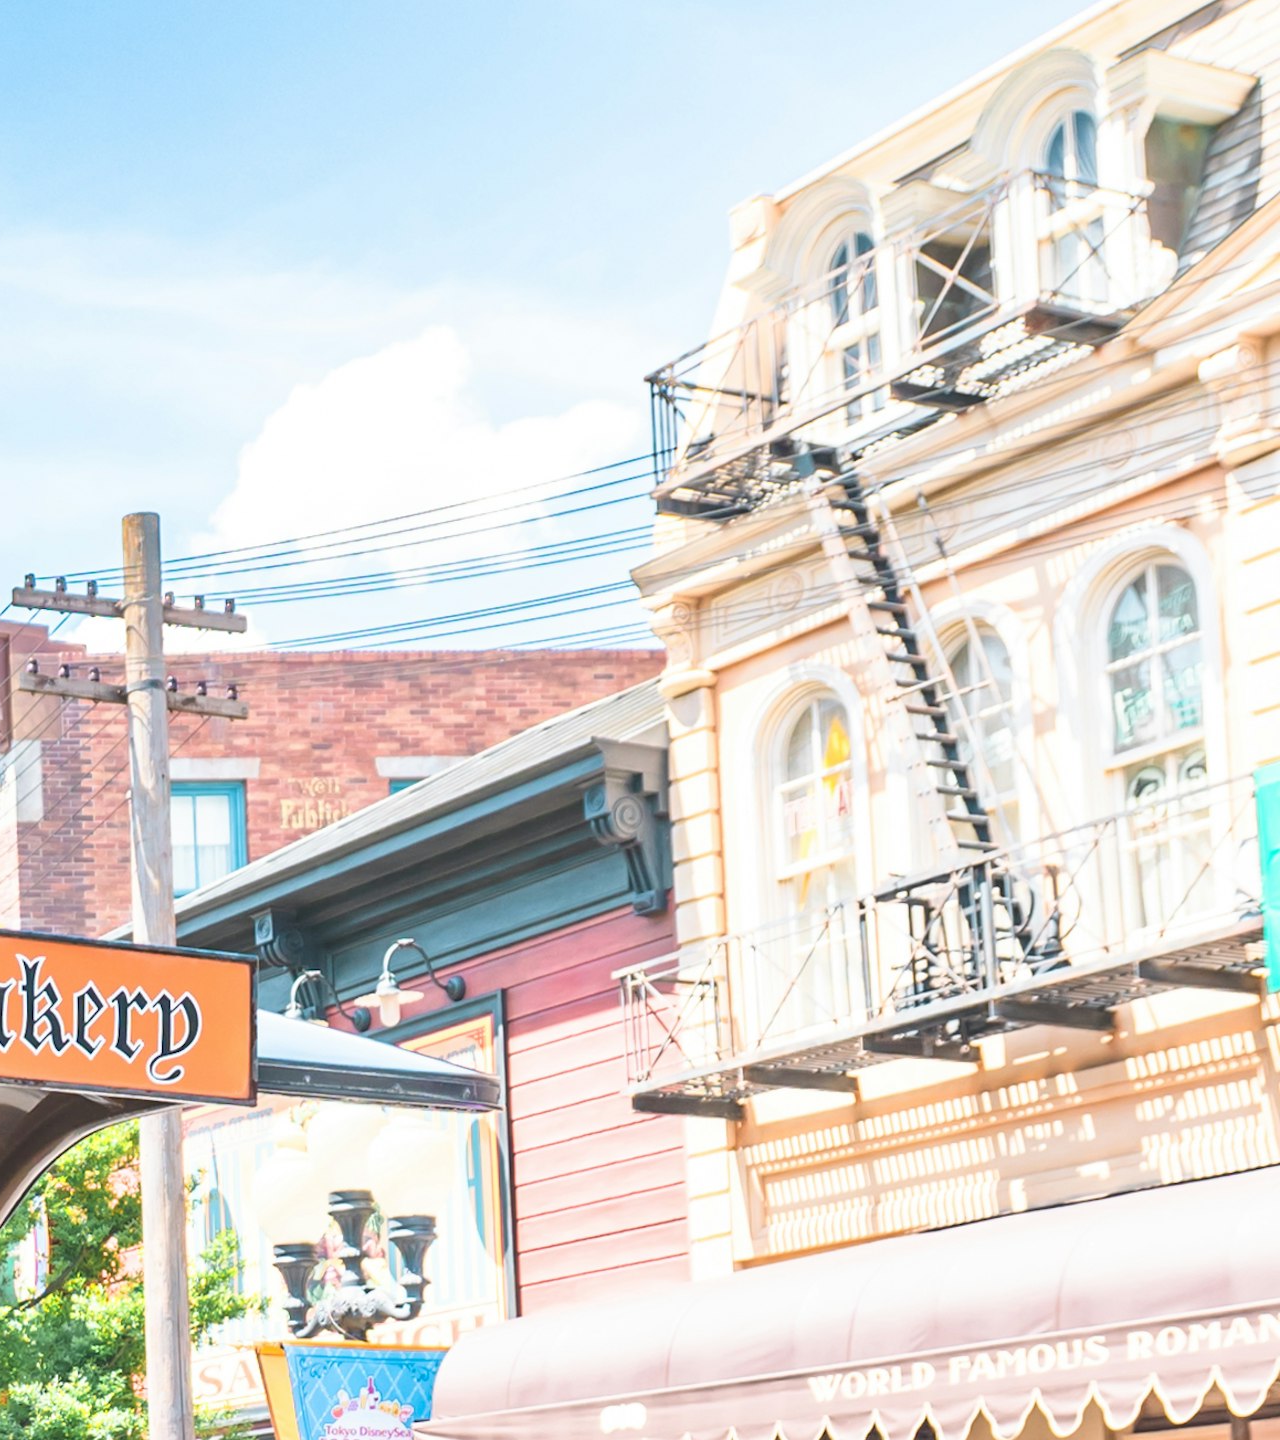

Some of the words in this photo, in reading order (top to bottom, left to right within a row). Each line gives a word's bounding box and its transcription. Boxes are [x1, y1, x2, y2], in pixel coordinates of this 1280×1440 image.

[806, 1362, 936, 1403] WORLD
[948, 1334, 1111, 1385] FAMOUS
[325, 1425, 358, 1438] Tokyo
[359, 1426, 413, 1439] DisneySea
